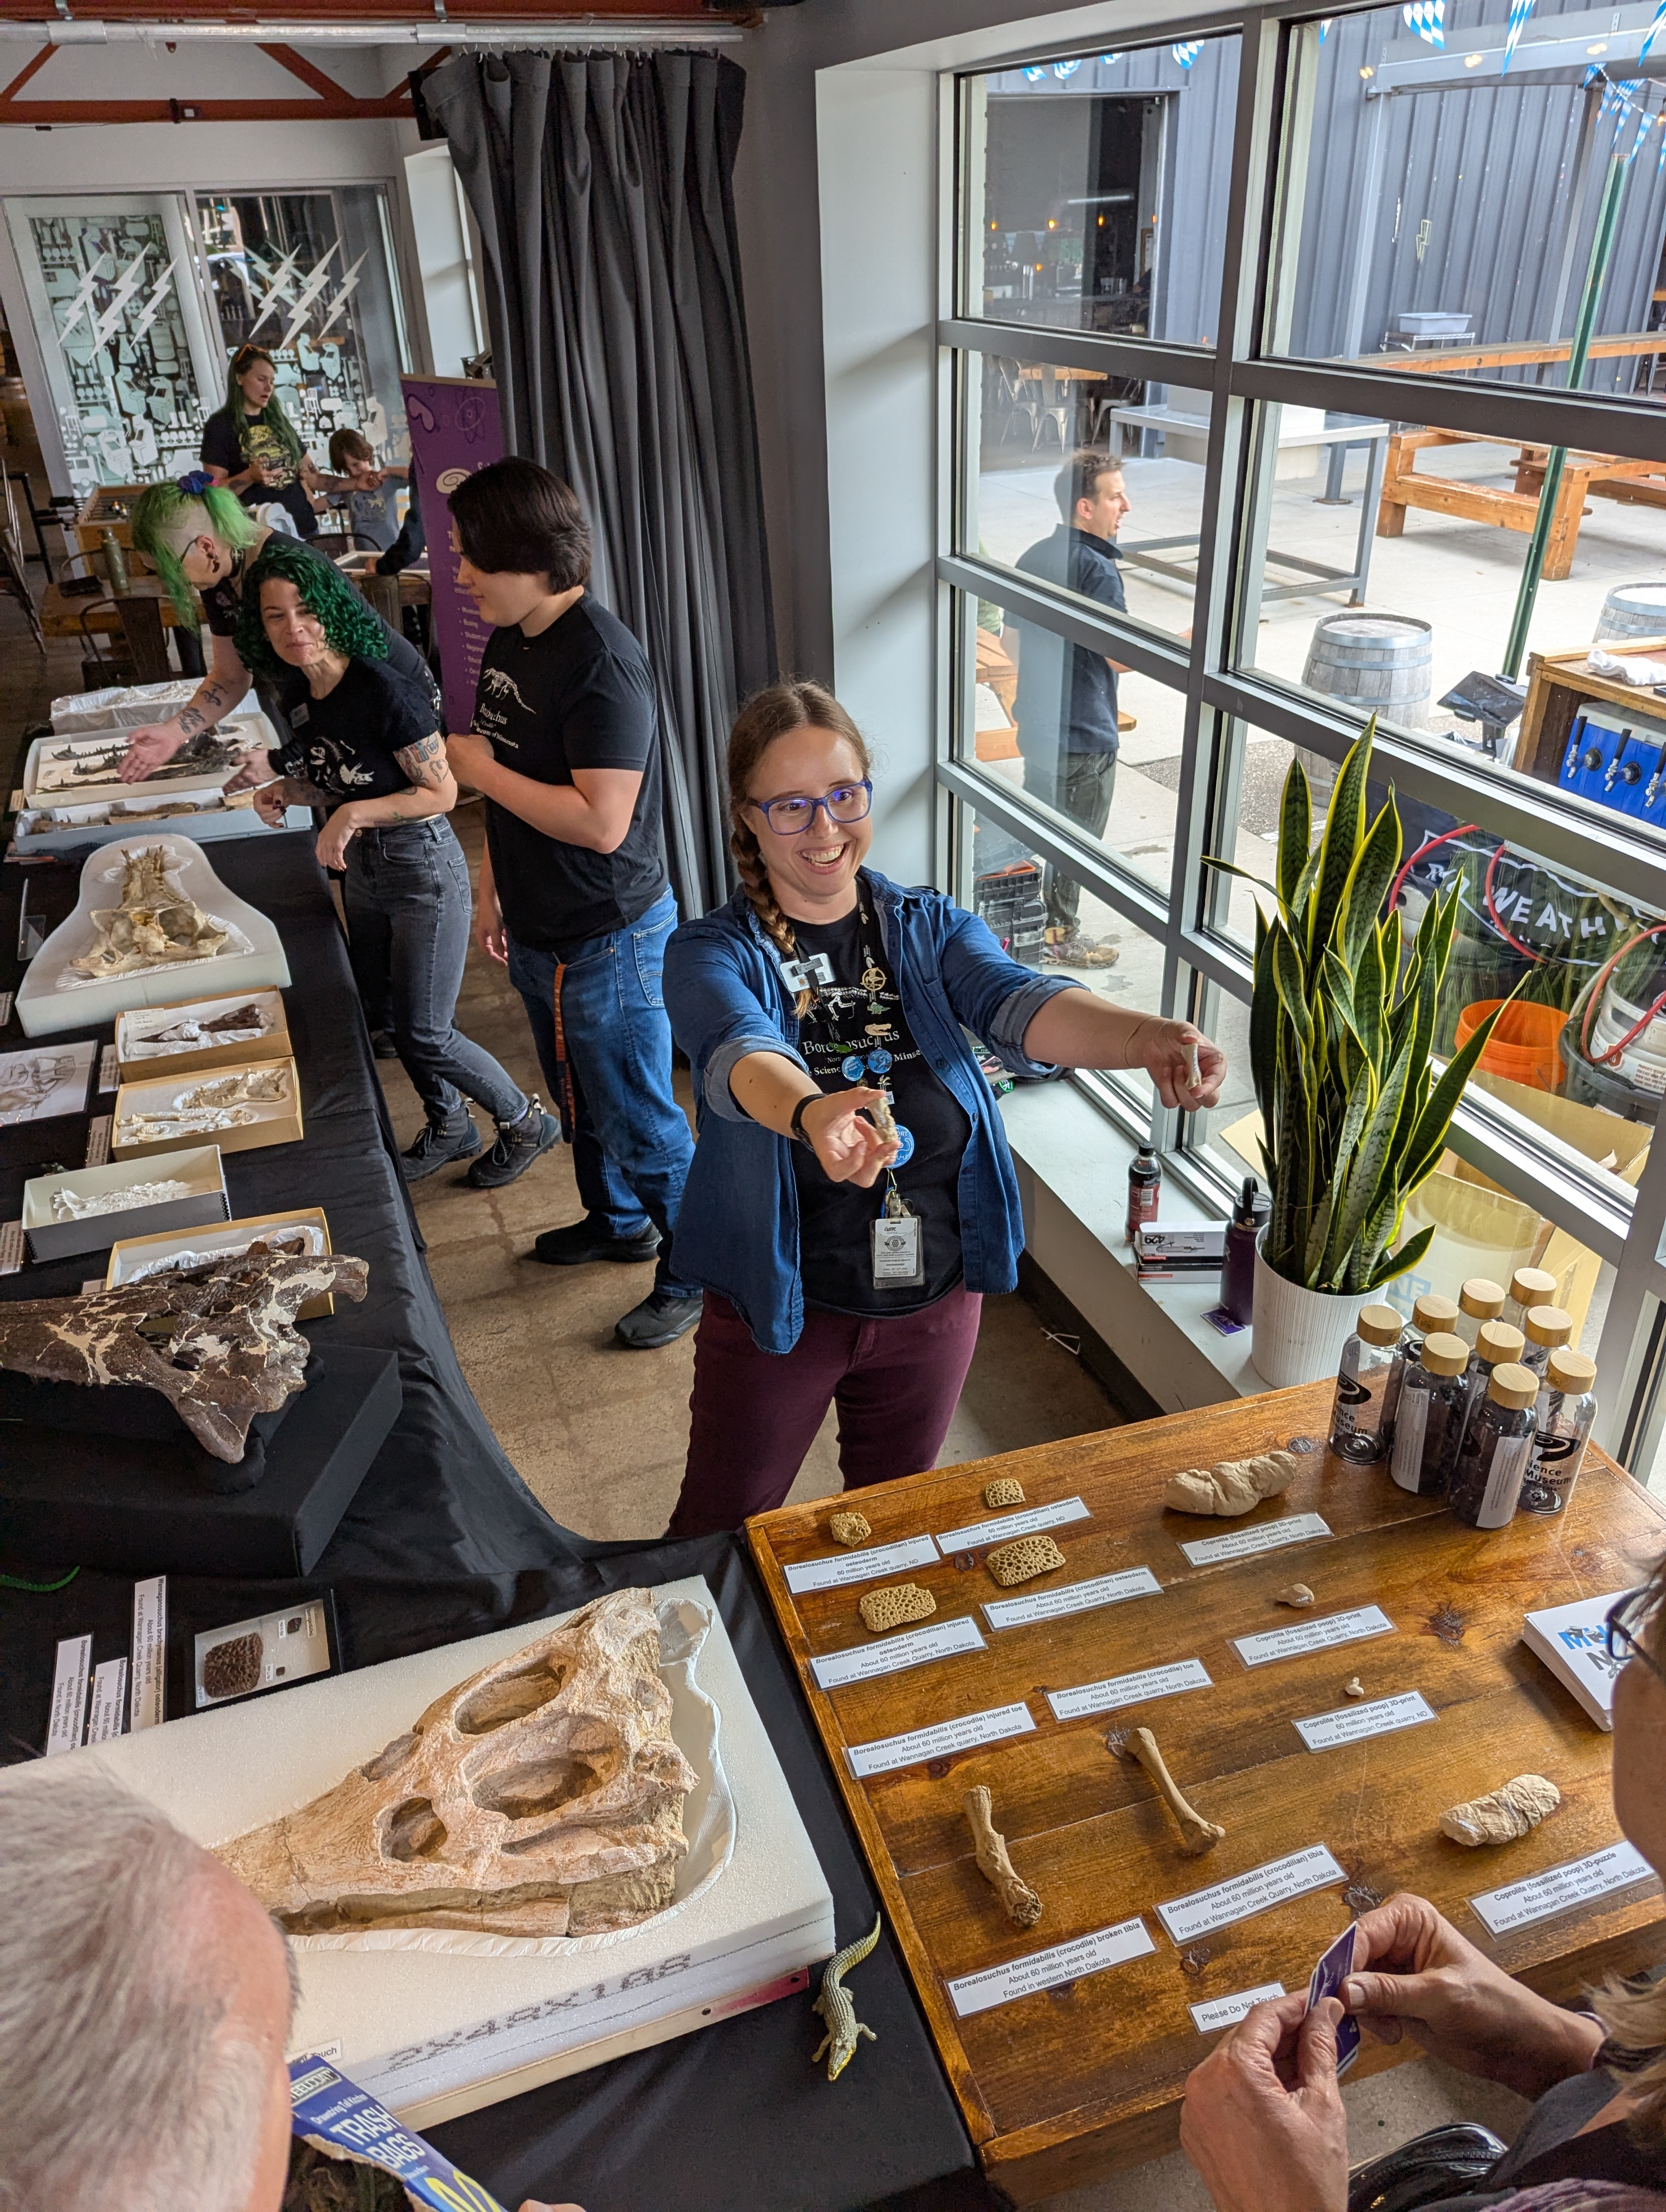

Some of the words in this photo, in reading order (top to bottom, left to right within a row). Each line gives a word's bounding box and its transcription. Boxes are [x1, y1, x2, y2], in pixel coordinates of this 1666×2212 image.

[1144, 1234, 1165, 1244] 429
[1526, 1469, 1572, 1485] Museum
[990, 1597, 1037, 1611] Borealosuchus
[1037, 1588, 1074, 1600] formidabilis
[1075, 1578, 1114, 1592] (crocodilian)
[1114, 1571, 1147, 1581] osteoderm
[1005, 1614, 1026, 1622] Found
[1032, 1606, 1066, 1617] Wannagan
[1066, 1600, 1085, 1609] Creek
[1124, 1586, 1145, 1594] Dakota
[1036, 1600, 1054, 1609] About
[1063, 1594, 1082, 1602] million
[1082, 1590, 1100, 1598] years
[1255, 1632, 1285, 1642] Coprolite
[1317, 1618, 1336, 1628] poop)
[1335, 1612, 1362, 1622] 3D-print
[1056, 1684, 1107, 1699] Borealosuchus
[1107, 1674, 1147, 1688] formidabilis
[1147, 1665, 1183, 1679] (crocodile)
[1059, 1706, 1081, 1716] Found
[1087, 1697, 1123, 1709] Wannagan
[1123, 1692, 1143, 1701] Creek
[1165, 1682, 1184, 1690] North
[1183, 1678, 1207, 1686] Dakota
[1091, 1691, 1110, 1700] About
[1119, 1684, 1140, 1693] million
[1140, 1680, 1158, 1689] years
[1303, 1718, 1335, 1729] Coprolite
[1368, 1702, 1389, 1713] poop)
[1388, 1695, 1417, 1706] 3D-print
[854, 1738, 906, 1756] Borealosuchus
[907, 1726, 948, 1742] formidabilis
[949, 1715, 986, 1731] (crocodile)
[985, 1708, 1011, 1719] injured
[868, 1760, 890, 1770] Found
[898, 1749, 935, 1763] Wannagan
[935, 1742, 956, 1752] Creek
[979, 1731, 998, 1740] North
[998, 1725, 1022, 1735] Dakota
[902, 1742, 921, 1753] About
[932, 1734, 953, 1744] million
[953, 1729, 972, 1739] years
[1167, 1890, 1221, 1914] Borealosuchus
[1221, 1873, 1264, 1894] formidabilis
[1264, 1855, 1309, 1877] (crocodilian)
[1307, 1850, 1324, 1860] tibia
[1211, 1898, 1232, 1911] About
[1231, 1893, 1241, 1902] 60
[1241, 1885, 1265, 1898] million
[1263, 1877, 1284, 1890] years
[1283, 1872, 1295, 1881] old
[1494, 1886, 1527, 1901] Coprolite
[1562, 1864, 1584, 1878] poop)
[1581, 1853, 1617, 1869] 3D-puzzle
[1523, 1892, 1545, 1904] About
[1542, 1888, 1553, 1896] 60
[1552, 1881, 1574, 1893] million
[1573, 1874, 1593, 1886] years
[1592, 1868, 1604, 1878] old
[1178, 1920, 1202, 1934] Found
[1202, 1918, 1212, 1926] at
[1209, 1905, 1248, 1922] Wannagan
[1247, 1895, 1269, 1908] Creek
[1292, 1877, 1313, 1889] North
[1312, 1869, 1337, 1882] Dakota
[1493, 1913, 1517, 1927] Found
[1516, 1911, 1526, 1919] at
[1522, 1899, 1560, 1915] Wannagan
[1559, 1891, 1581, 1902] Creek
[1603, 1874, 1624, 1886] North
[1621, 1866, 1646, 1879] Dakota
[953, 1967, 1010, 1991] Borealosuchus
[1011, 1952, 1056, 1971] formidabilis
[1056, 1937, 1097, 1957] (crocodile)
[1095, 1929, 1123, 1943] broken
[1123, 1922, 1140, 1933] tibia
[1009, 1971, 1030, 1984] About
[1030, 1968, 1040, 1977] 60
[1041, 1962, 1065, 1973] million
[1064, 1954, 1085, 1966] years
[1085, 1949, 1097, 1958] old
[1003, 1984, 1027, 1998] Found
[1035, 1973, 1065, 1987] western
[1063, 1966, 1085, 1978] North
[1085, 1957, 1111, 1971] Dakota
[1201, 2009, 1228, 2022] Please
[1228, 2005, 1241, 2014] Do
[1241, 2000, 1255, 2011] Not
[329, 2105, 402, 2145] TRASH
[366, 2133, 426, 2169] BAGS
